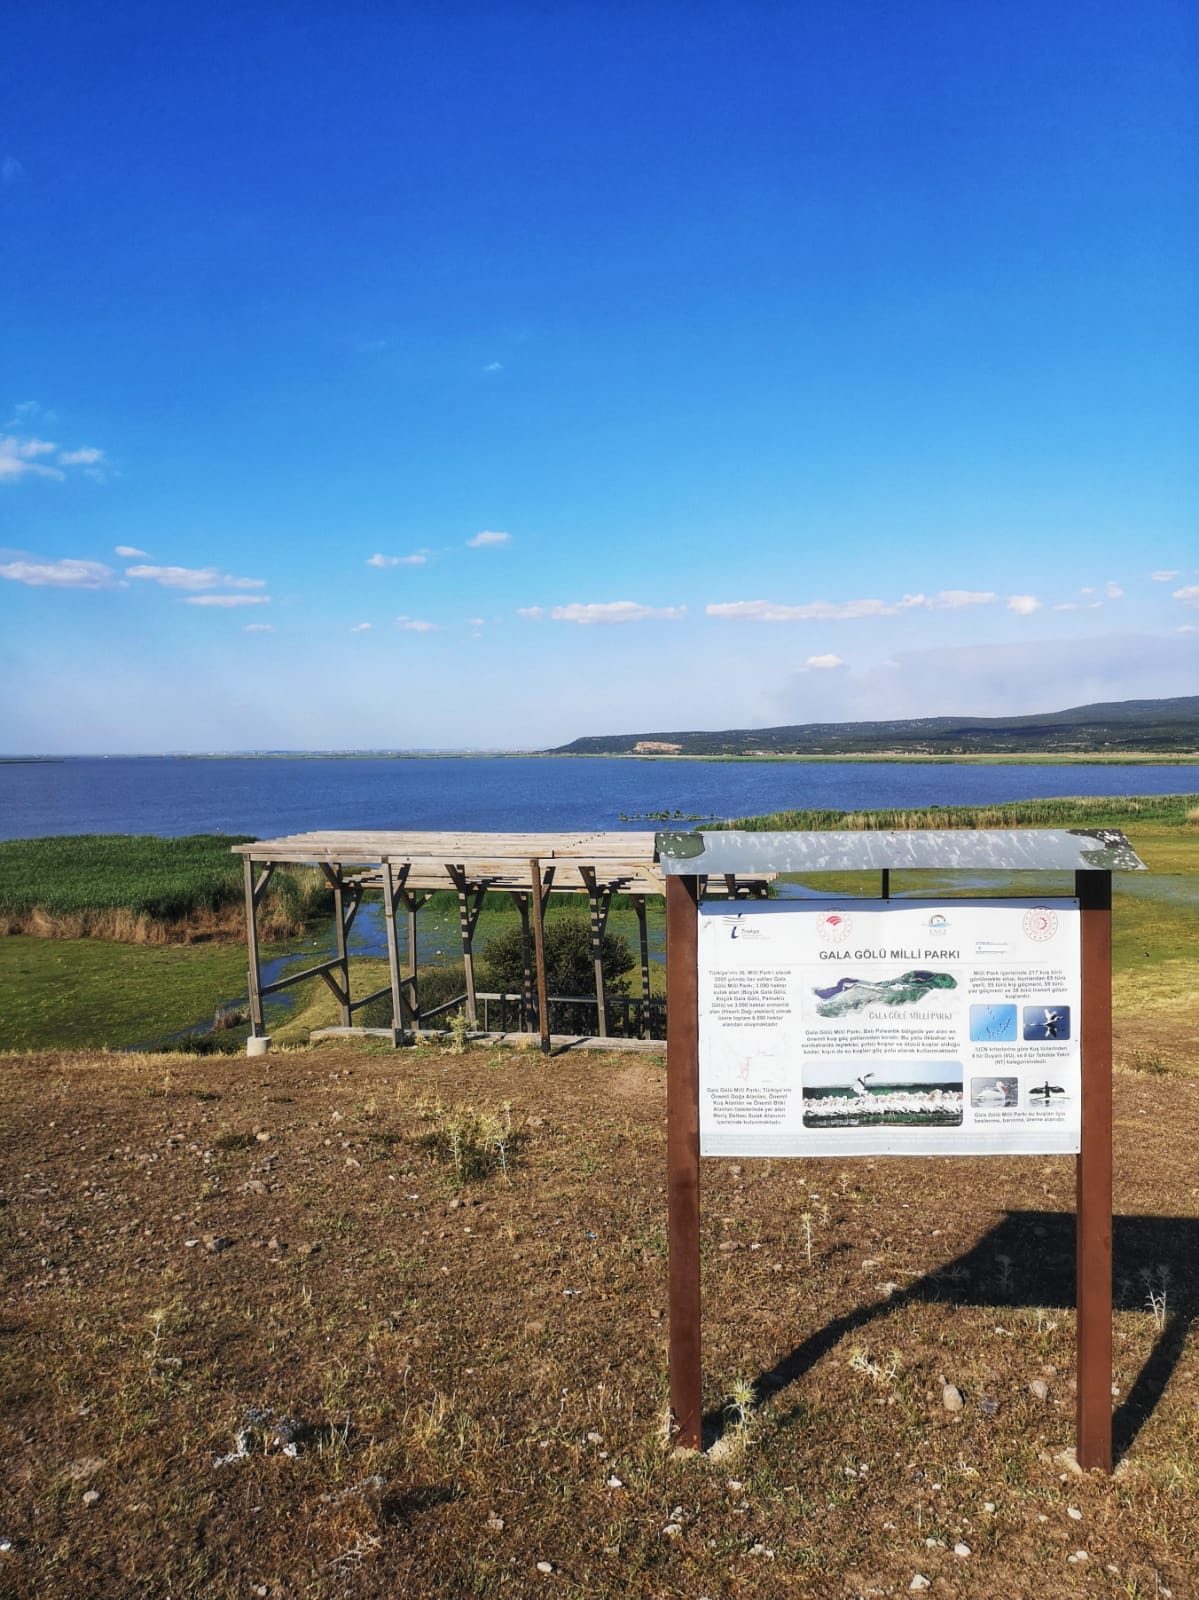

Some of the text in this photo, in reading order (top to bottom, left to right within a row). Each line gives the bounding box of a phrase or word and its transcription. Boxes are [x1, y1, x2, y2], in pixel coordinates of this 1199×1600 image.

[819, 948, 960, 960] GALA GÖLÜ MİLLİ PARKI
